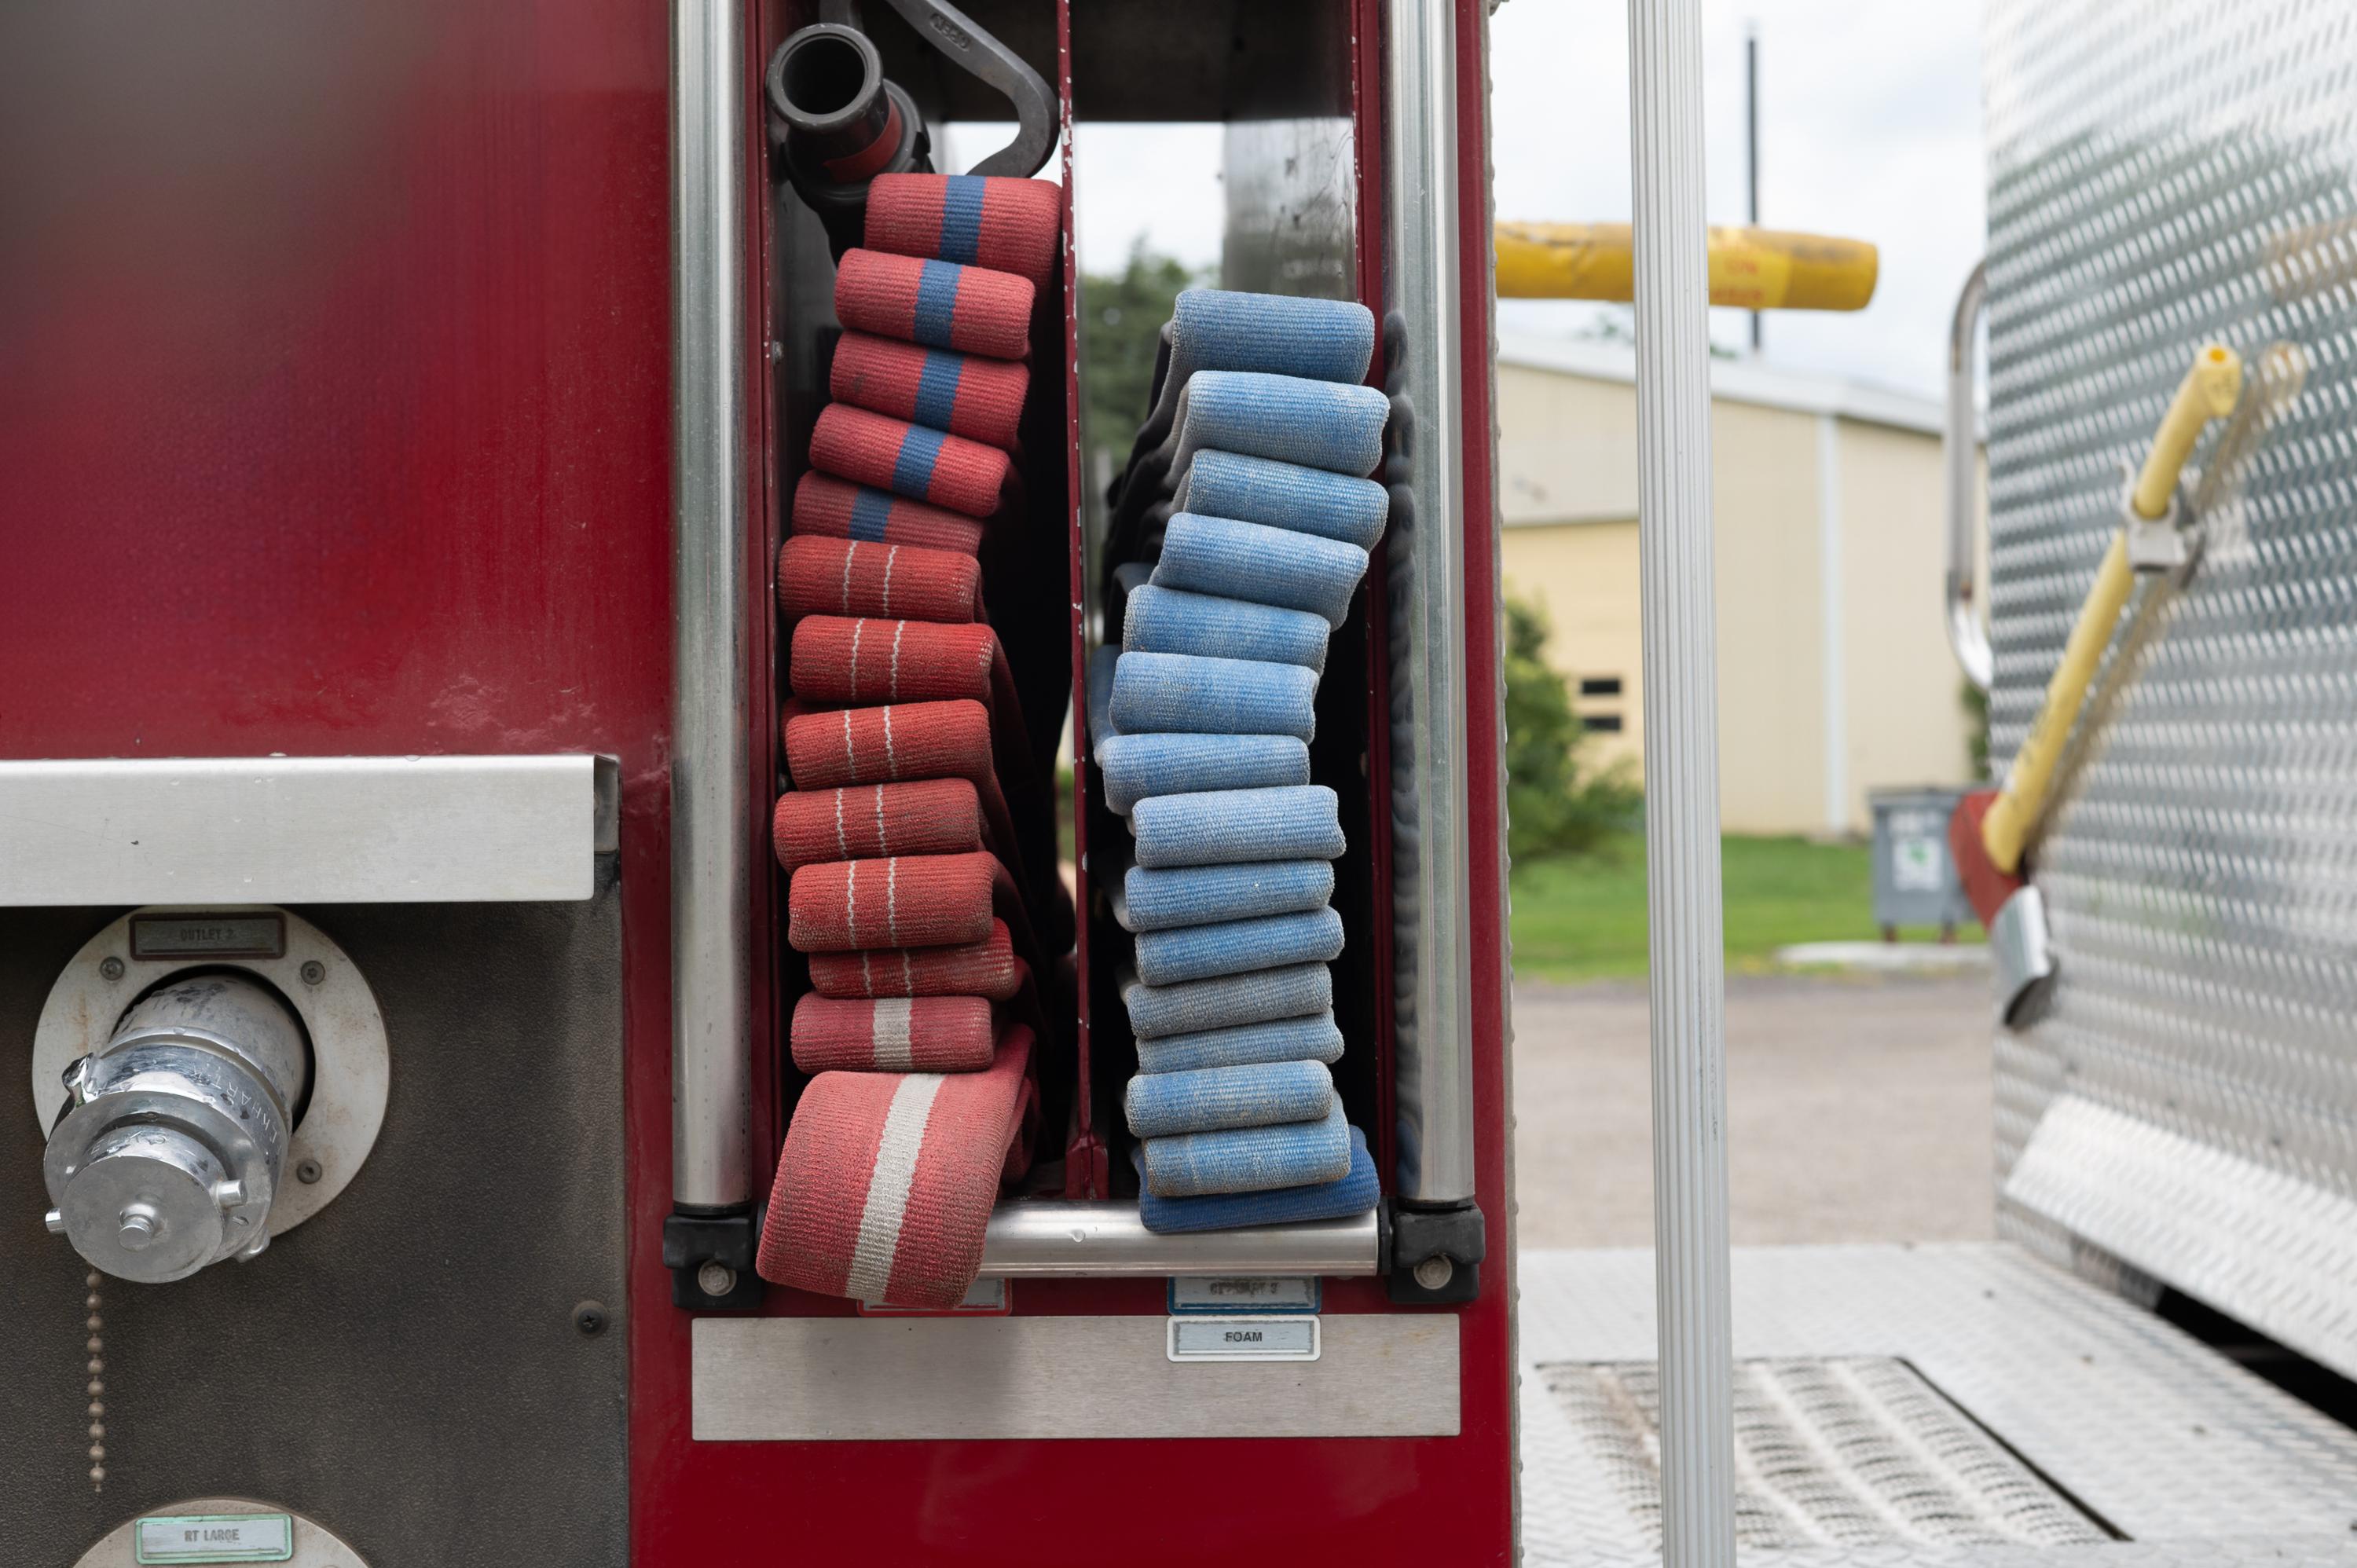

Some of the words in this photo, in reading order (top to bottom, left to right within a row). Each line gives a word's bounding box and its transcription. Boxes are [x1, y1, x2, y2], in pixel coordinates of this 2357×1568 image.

[180, 929, 222, 941] OUTLET
[1225, 1332, 1263, 1342] FOAM
[185, 1530, 200, 1542] RT
[203, 1529, 240, 1541] LARGE
